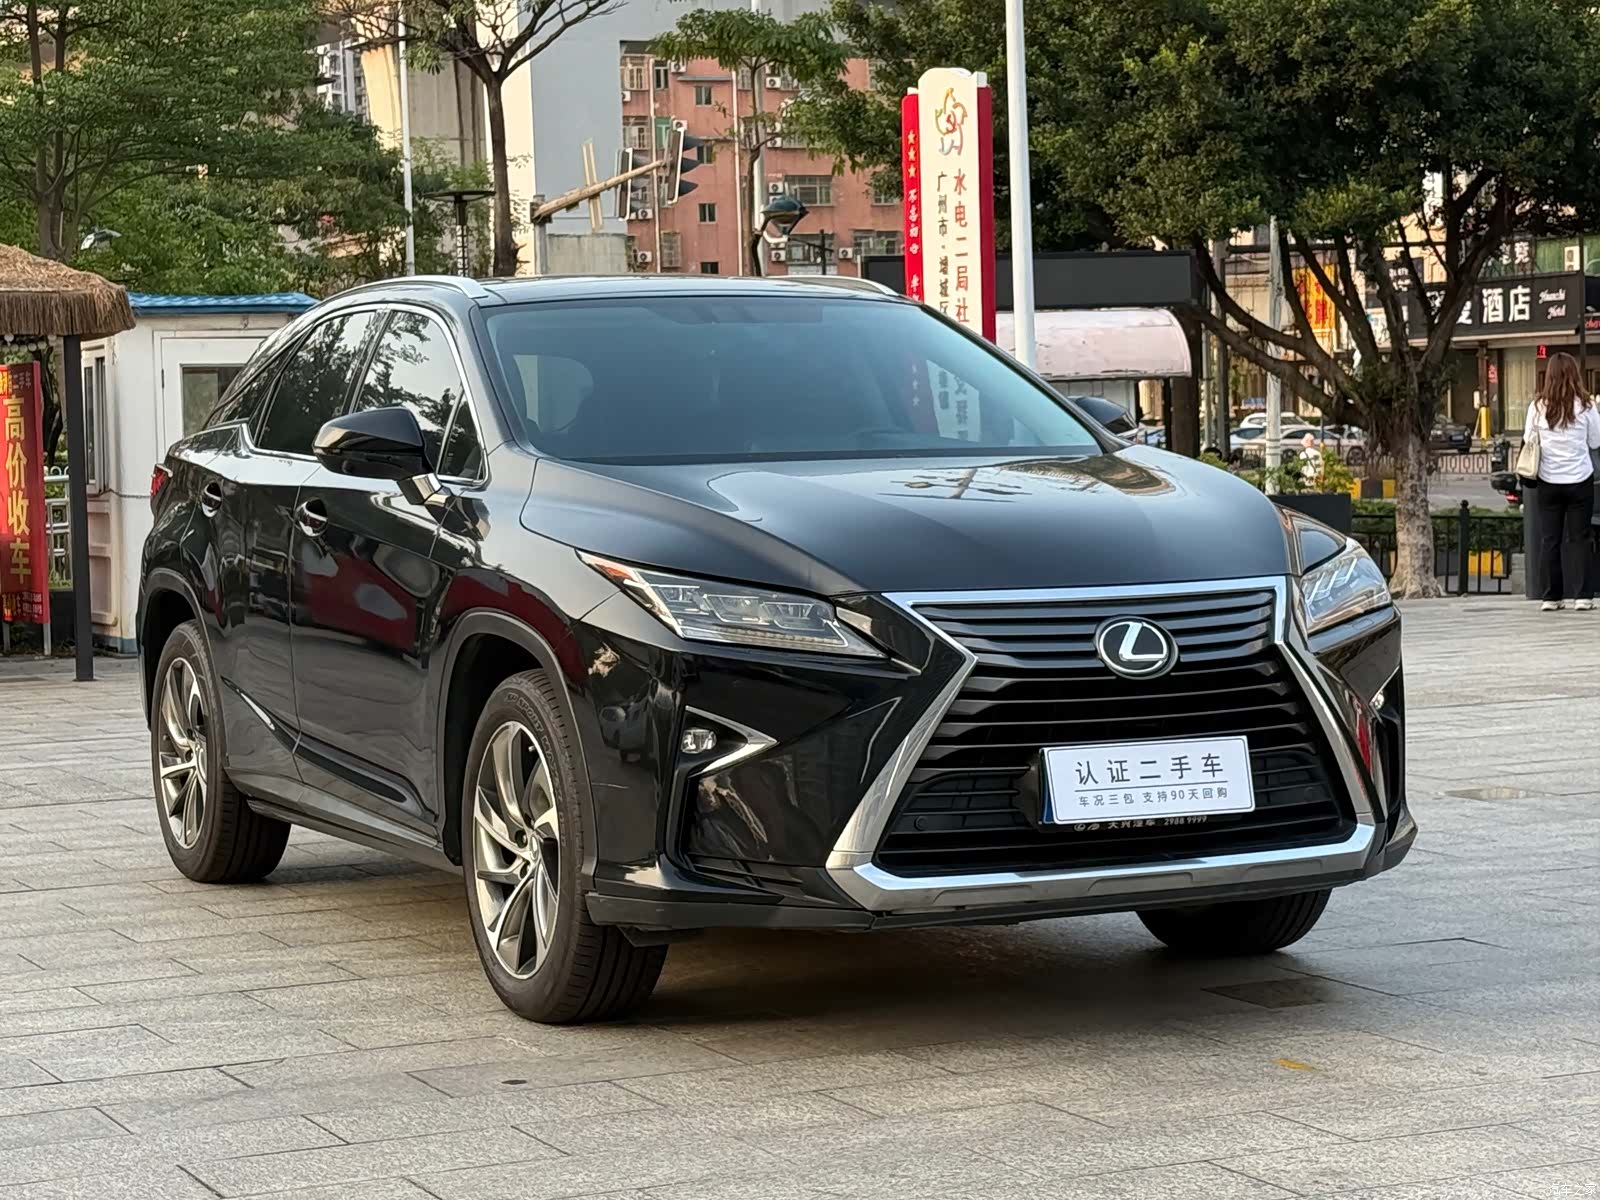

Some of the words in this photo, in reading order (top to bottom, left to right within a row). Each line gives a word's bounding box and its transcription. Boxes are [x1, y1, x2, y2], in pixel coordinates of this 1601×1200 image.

[953, 168, 970, 323] 水电二局社
[3, 394, 32, 585] 高价收车
[516, 696, 544, 733] SPORT
[1075, 753, 1223, 786] 认证二手车
[1079, 793, 1134, 807] 车况三包
[1142, 786, 1228, 804] 支持90天回购
